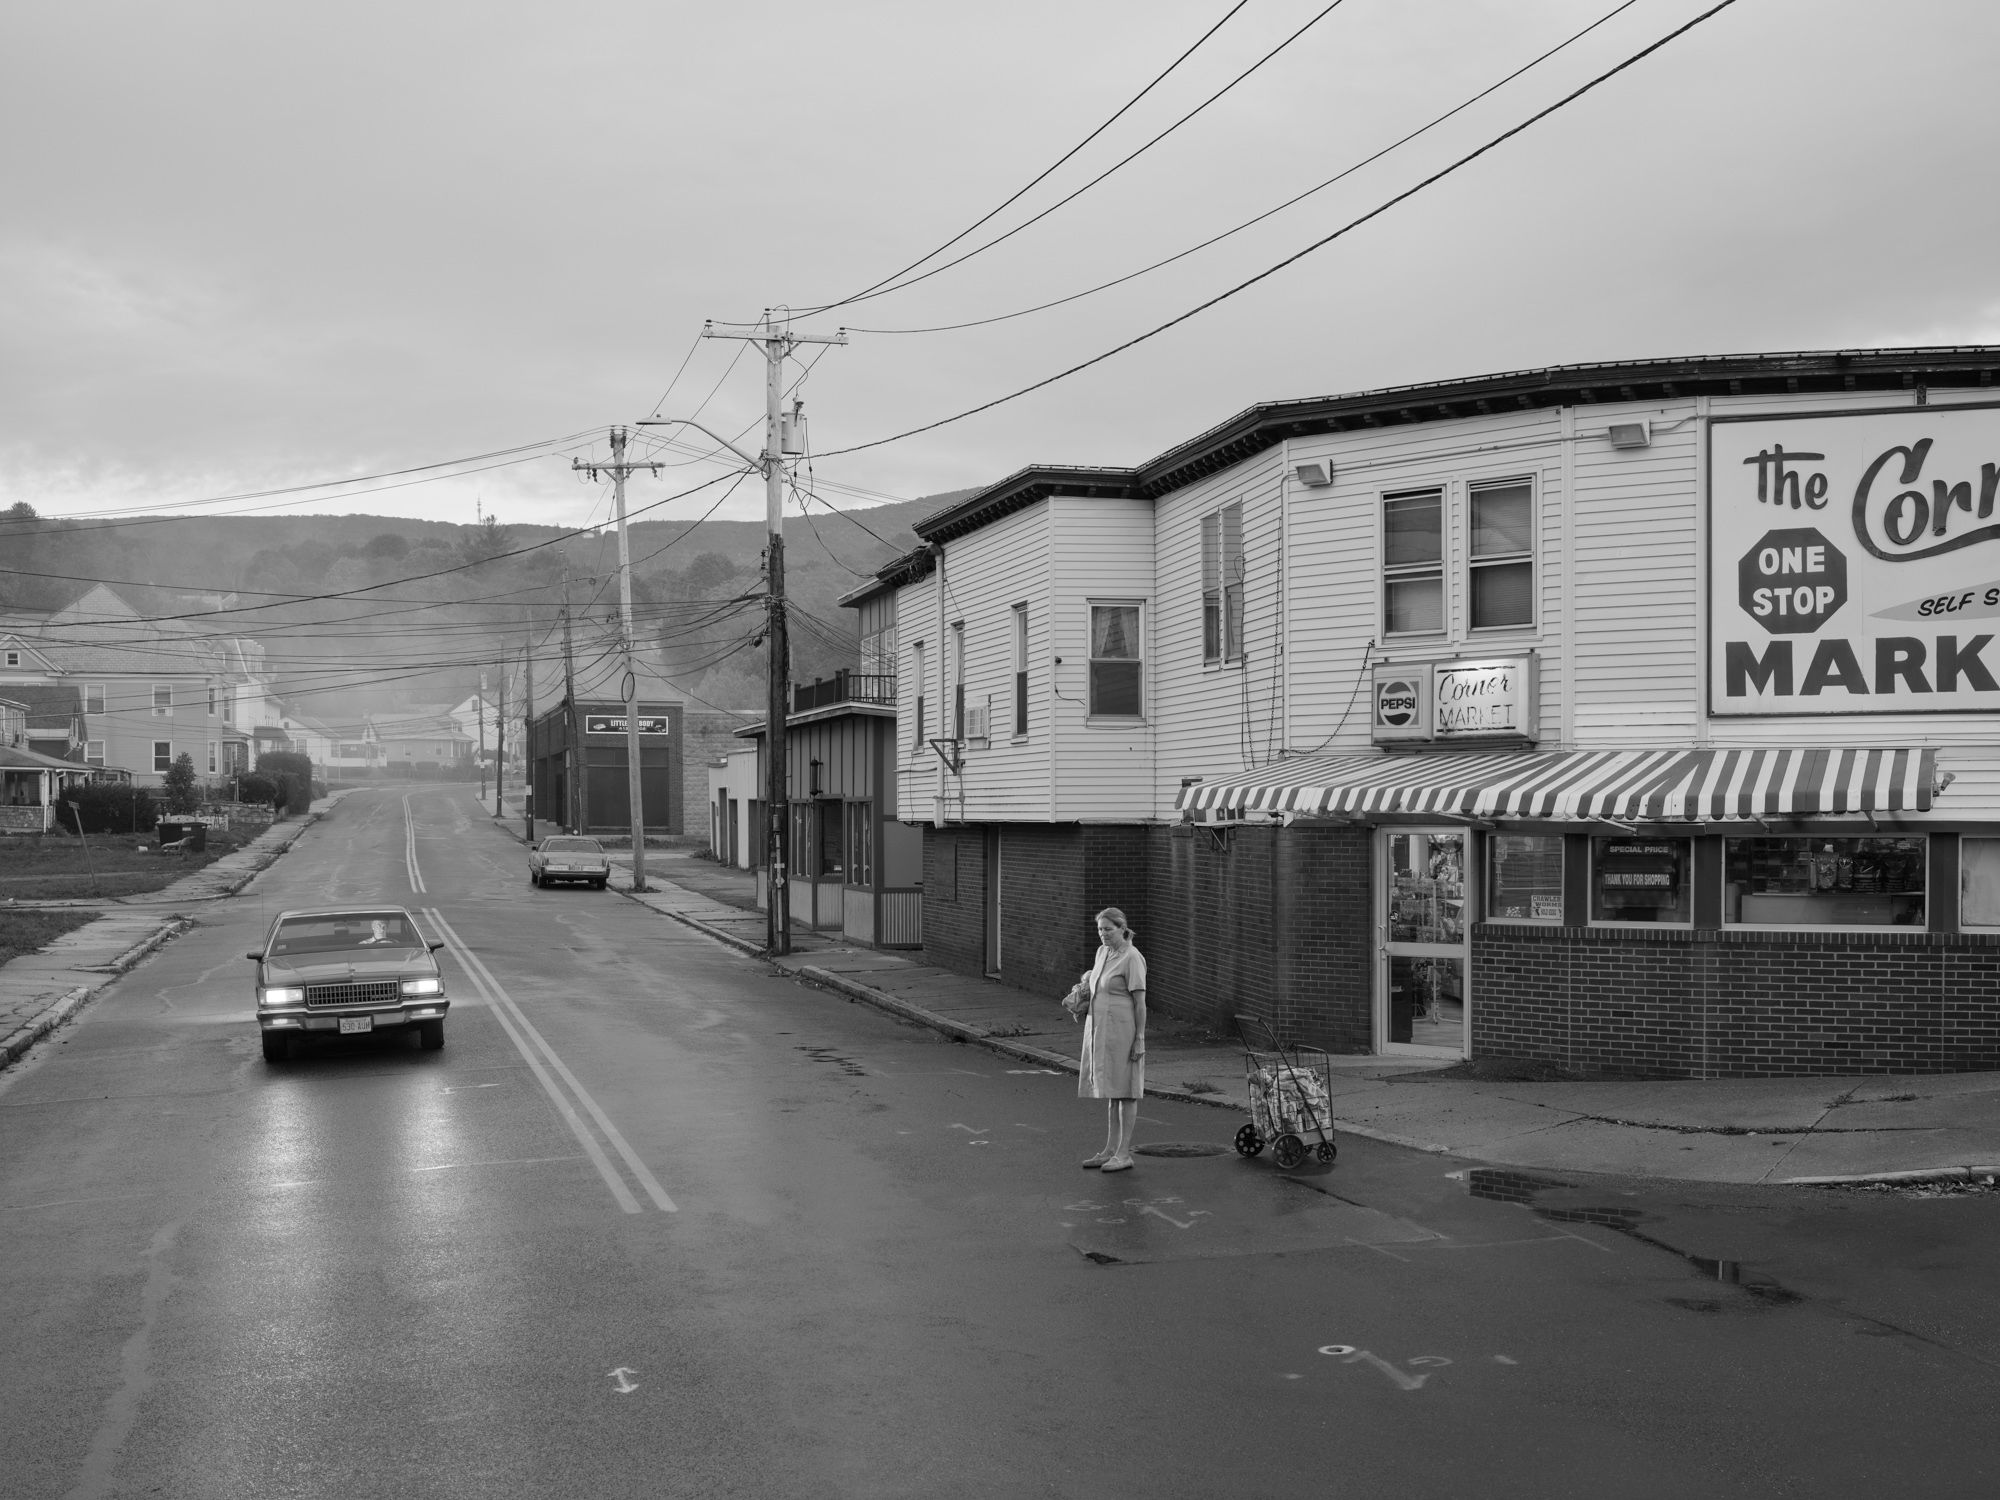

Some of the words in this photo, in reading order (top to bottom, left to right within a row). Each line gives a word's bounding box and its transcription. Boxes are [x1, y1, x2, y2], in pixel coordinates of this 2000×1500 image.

[1743, 443, 1829, 511] the
[1758, 546, 1825, 575] ONE
[1753, 586, 1835, 617] STOP
[1917, 592, 1975, 616] SELF
[1726, 634, 2000, 697] MARK
[1380, 697, 1415, 709] PEPSI
[1437, 673, 1512, 704] Corner
[1439, 704, 1513, 726] MARKET
[1604, 874, 1621, 885] THANK
[1622, 874, 1633, 885] YOU
[1633, 874, 1644, 886] FOR
[1644, 874, 1670, 886] SHOPPING
